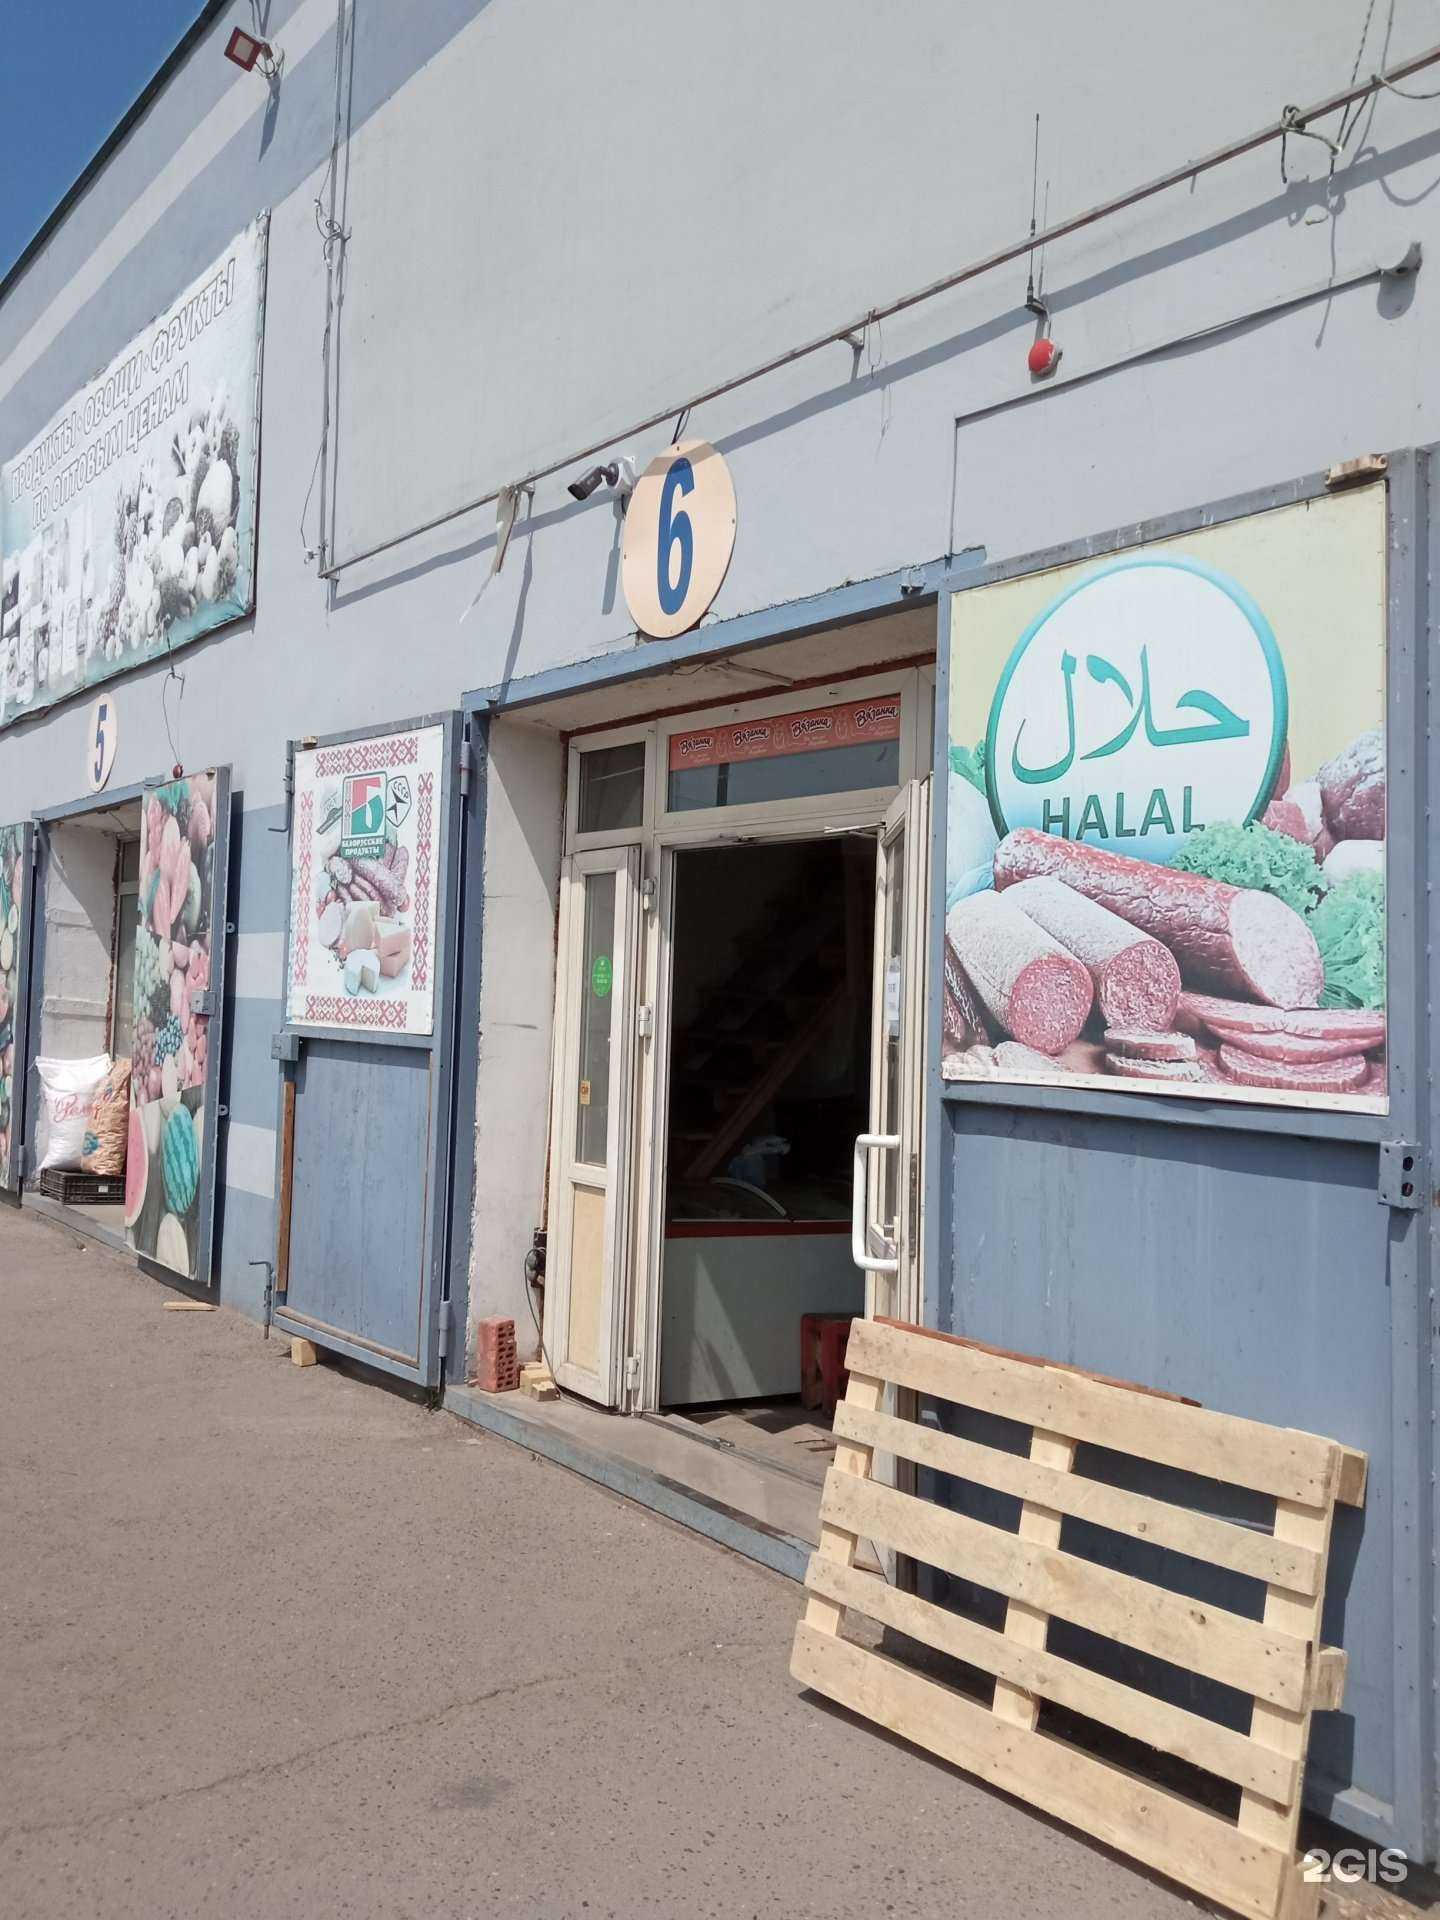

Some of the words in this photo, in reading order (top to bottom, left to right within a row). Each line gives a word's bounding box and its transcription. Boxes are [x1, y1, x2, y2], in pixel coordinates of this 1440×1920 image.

[11, 410, 77, 503] ПРОДУКТЫ
[84, 350, 143, 435] ОВОЩИ
[151, 257, 236, 374] ФРУКТЫ
[32, 486, 49, 529] ПО
[53, 420, 123, 512] ОПТОВЫМ
[126, 361, 189, 454] ЦЕНАМ
[656, 457, 695, 616] 6
[94, 703, 108, 783] 5
[1010, 643, 1250, 785] حلال
[345, 847, 380, 857] ПРОДУКТЫ
[1041, 784, 1205, 841] HALAL
